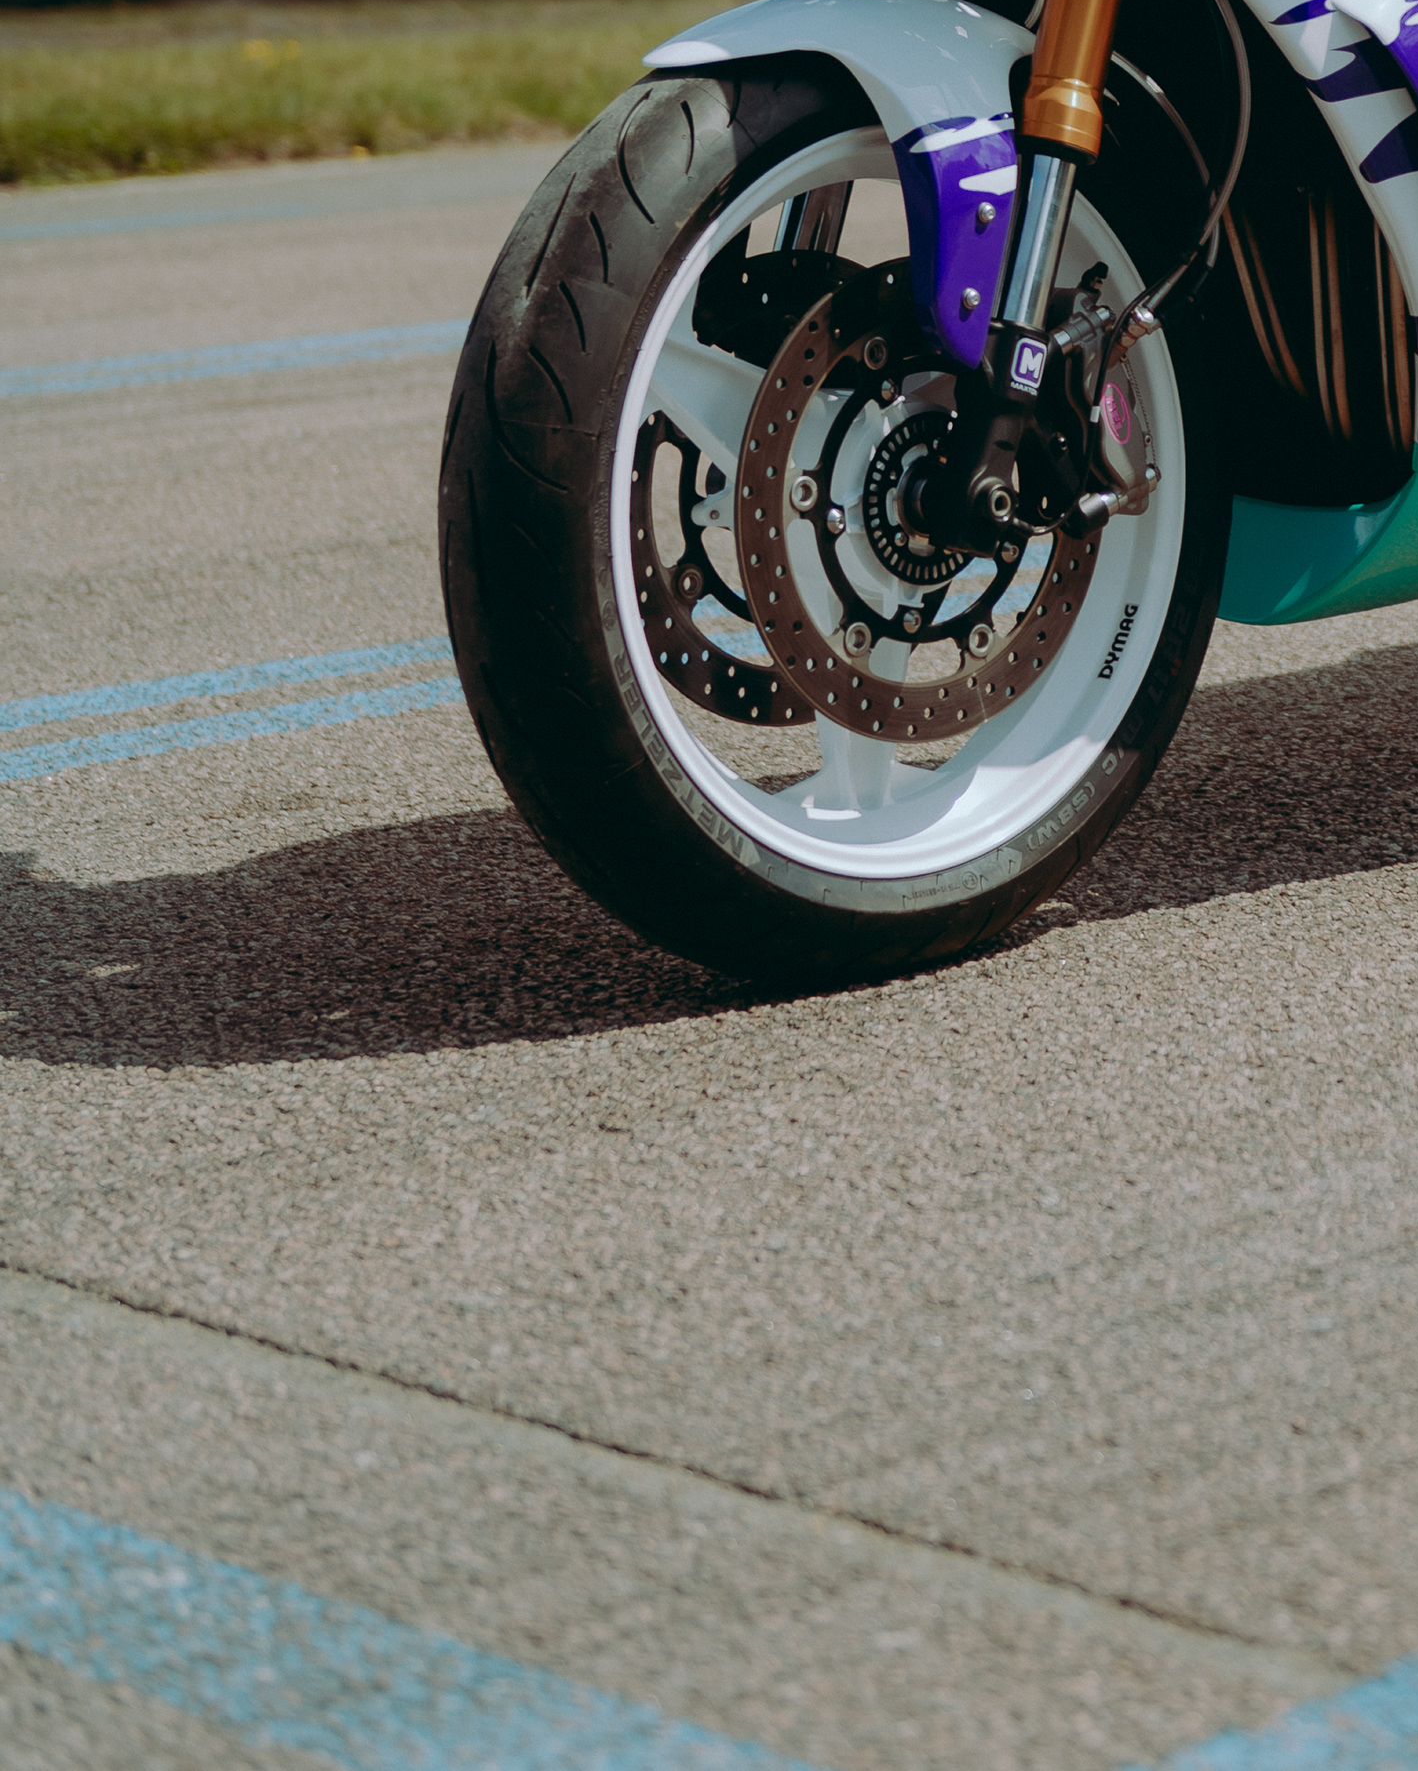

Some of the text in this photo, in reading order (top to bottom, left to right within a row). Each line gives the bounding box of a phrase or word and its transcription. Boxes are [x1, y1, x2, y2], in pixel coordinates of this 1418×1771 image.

[1020, 347, 1043, 379] M
[1098, 603, 1139, 680] DYMAG
[612, 649, 747, 860] METZELER
